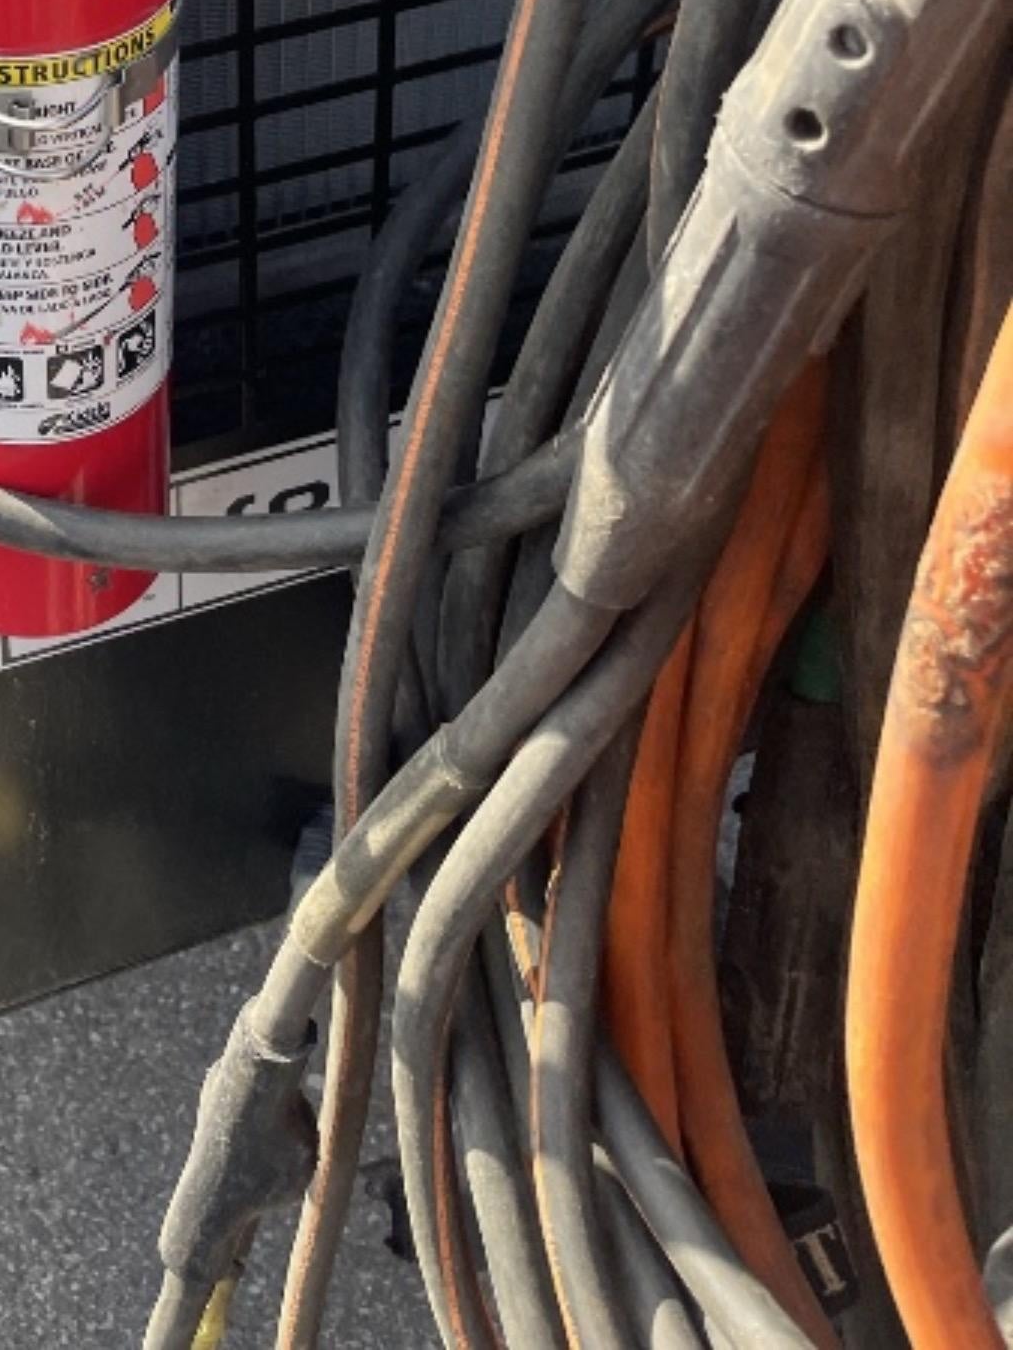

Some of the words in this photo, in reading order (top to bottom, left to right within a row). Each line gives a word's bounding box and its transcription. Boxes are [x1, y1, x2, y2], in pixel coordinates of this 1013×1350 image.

[40, 225, 71, 238] AND
[26, 288, 58, 300] SIDE
[62, 284, 77, 296] TO
